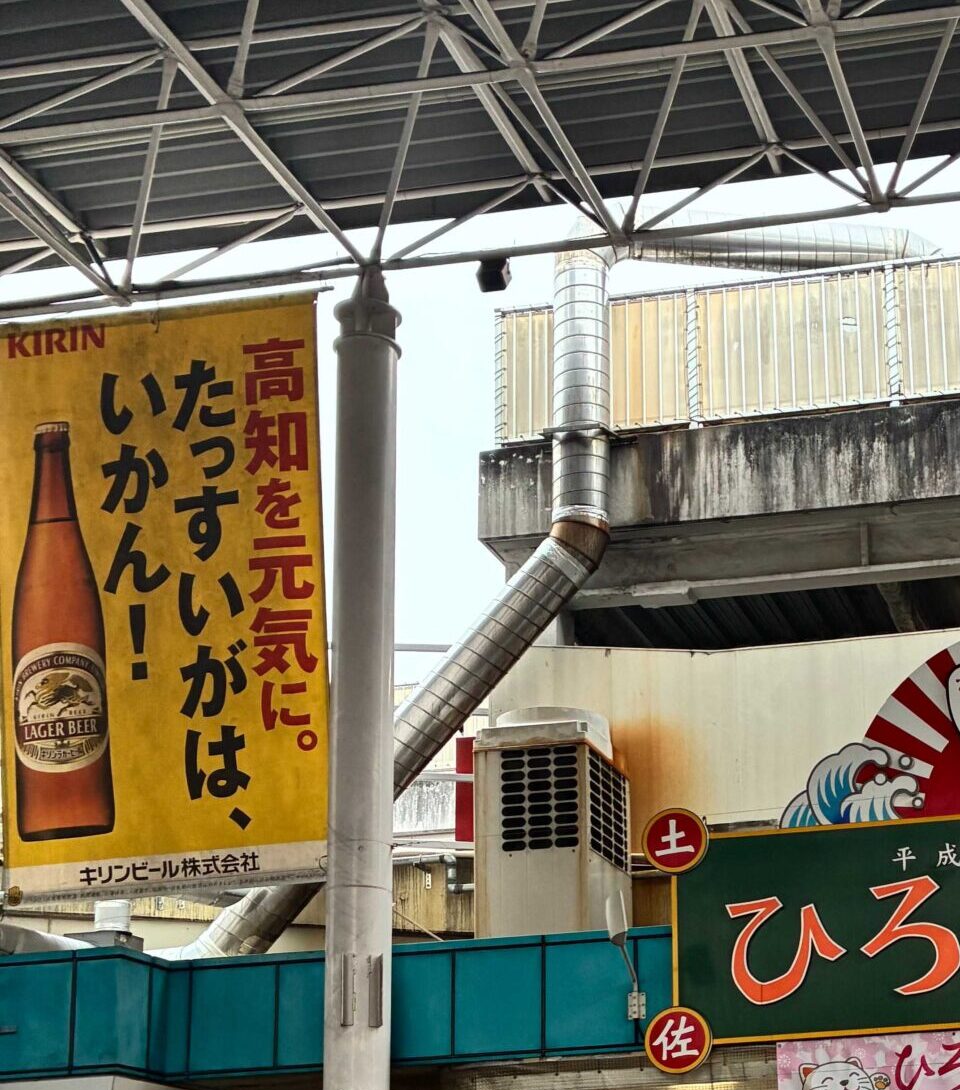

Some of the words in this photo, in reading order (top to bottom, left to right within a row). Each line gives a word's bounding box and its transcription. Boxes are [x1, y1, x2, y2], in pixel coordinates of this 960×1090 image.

[8, 323, 105, 359] KIRIN
[100, 371, 171, 681] いかん!
[242, 337, 318, 752] 高知を元気に。
[172, 359, 252, 830] たっすいがは、
[53, 654, 89, 670] COMPANY
[24, 720, 64, 740] LAGER
[68, 718, 98, 735] BEER
[655, 820, 695, 856] 土
[80, 851, 260, 886] キリンビール株式会社
[652, 1016, 699, 1061] 佐
